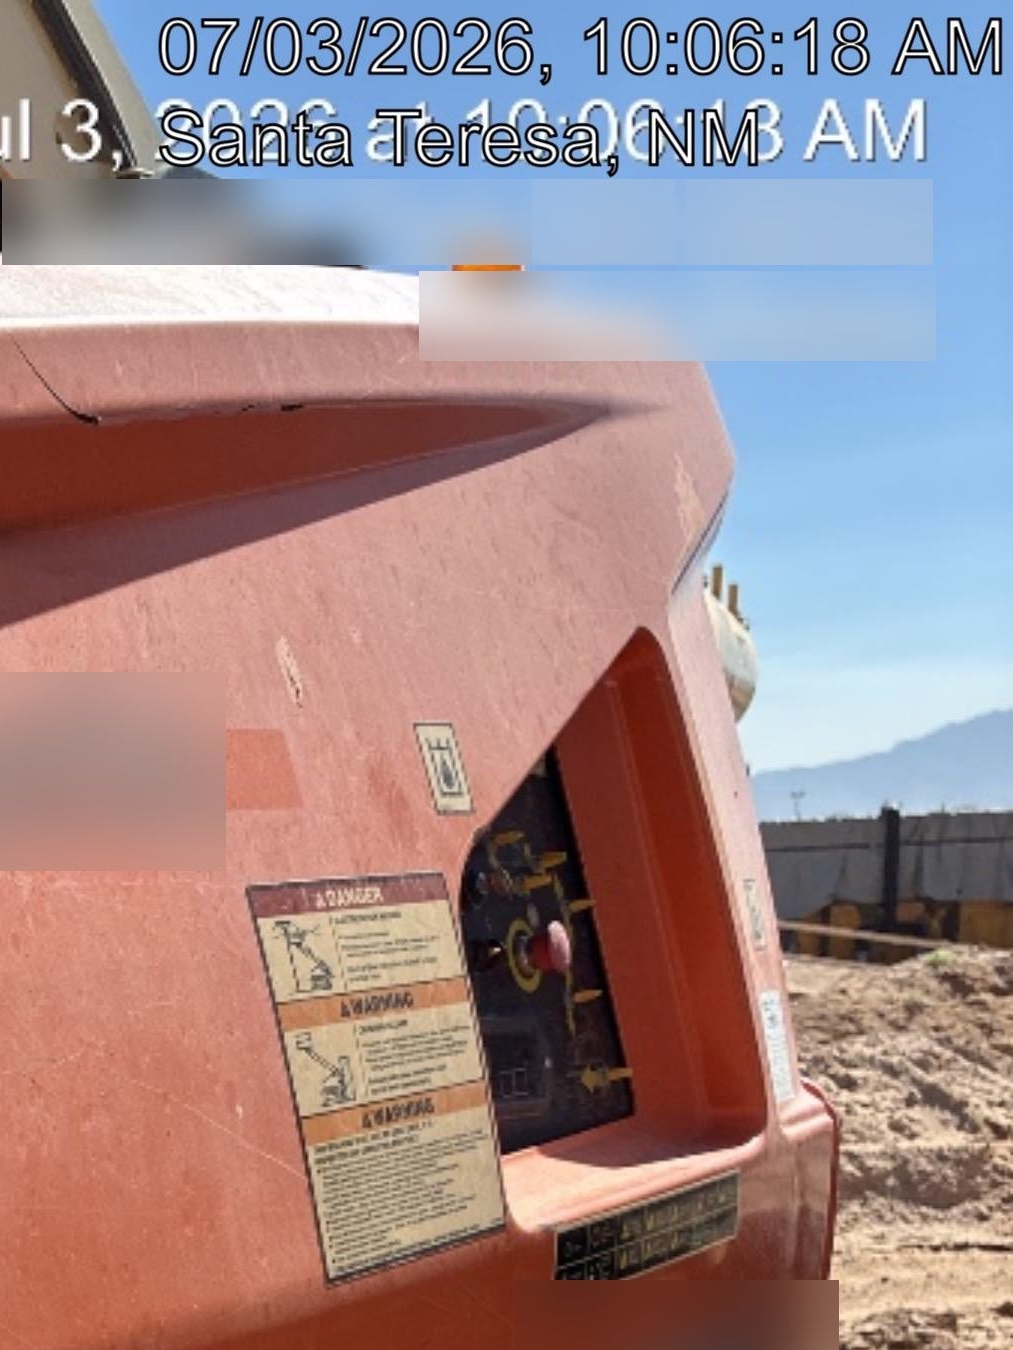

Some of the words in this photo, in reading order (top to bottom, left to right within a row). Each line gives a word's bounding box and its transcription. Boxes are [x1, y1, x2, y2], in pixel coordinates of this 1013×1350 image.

[324, 886, 385, 908] DANGER
[350, 991, 414, 1016] WARNING
[372, 1097, 435, 1126] WARNING
